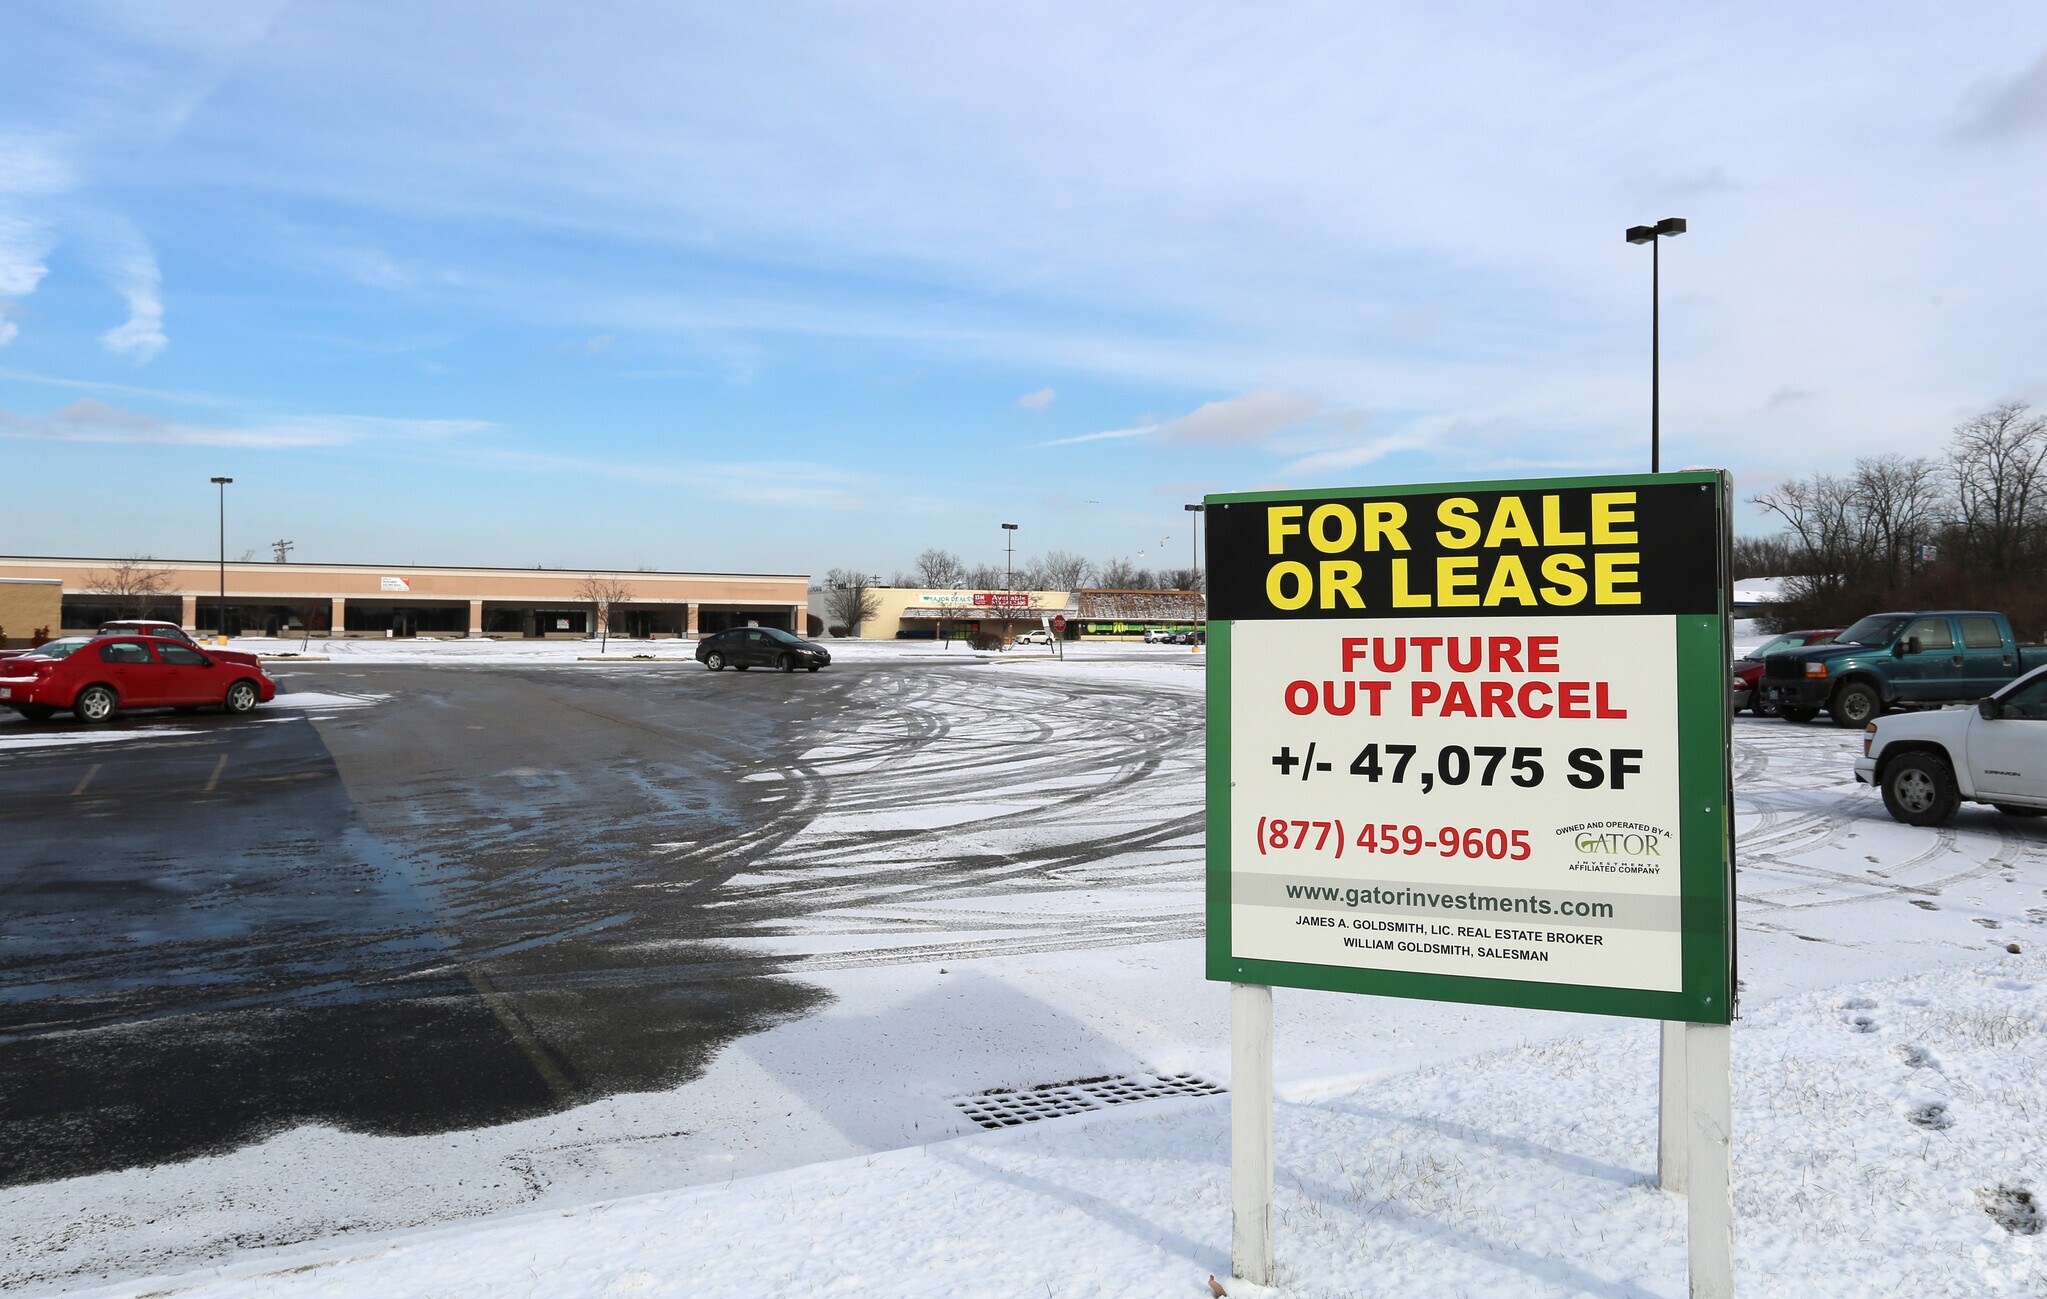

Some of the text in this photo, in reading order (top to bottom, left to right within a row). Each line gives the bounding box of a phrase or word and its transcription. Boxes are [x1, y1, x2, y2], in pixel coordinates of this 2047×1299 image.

[1267, 492, 1639, 555] FOR SALE
[1265, 552, 1642, 610] OR LEASE
[1342, 636, 1560, 673] FUTURE
[1284, 680, 1628, 719] OUT PARCEL
[1271, 742, 1643, 794] +/- 47,075 SF
[1256, 816, 1531, 861] (877) 459-9605
[1555, 821, 1673, 839] OWNED AND OPERATED BY A:
[1574, 832, 1661, 856] GATOR
[1568, 864, 1660, 875] AFFILIATED COMPANY
[1286, 884, 1614, 918] www.gatorinvestments.com
[1295, 916, 1603, 946] JAMES A. GOLDSMITH, LIC. REAL ESTATE BROKER
[1343, 937, 1549, 962] WILLIAM GOLDSMITH, SALESMAN
